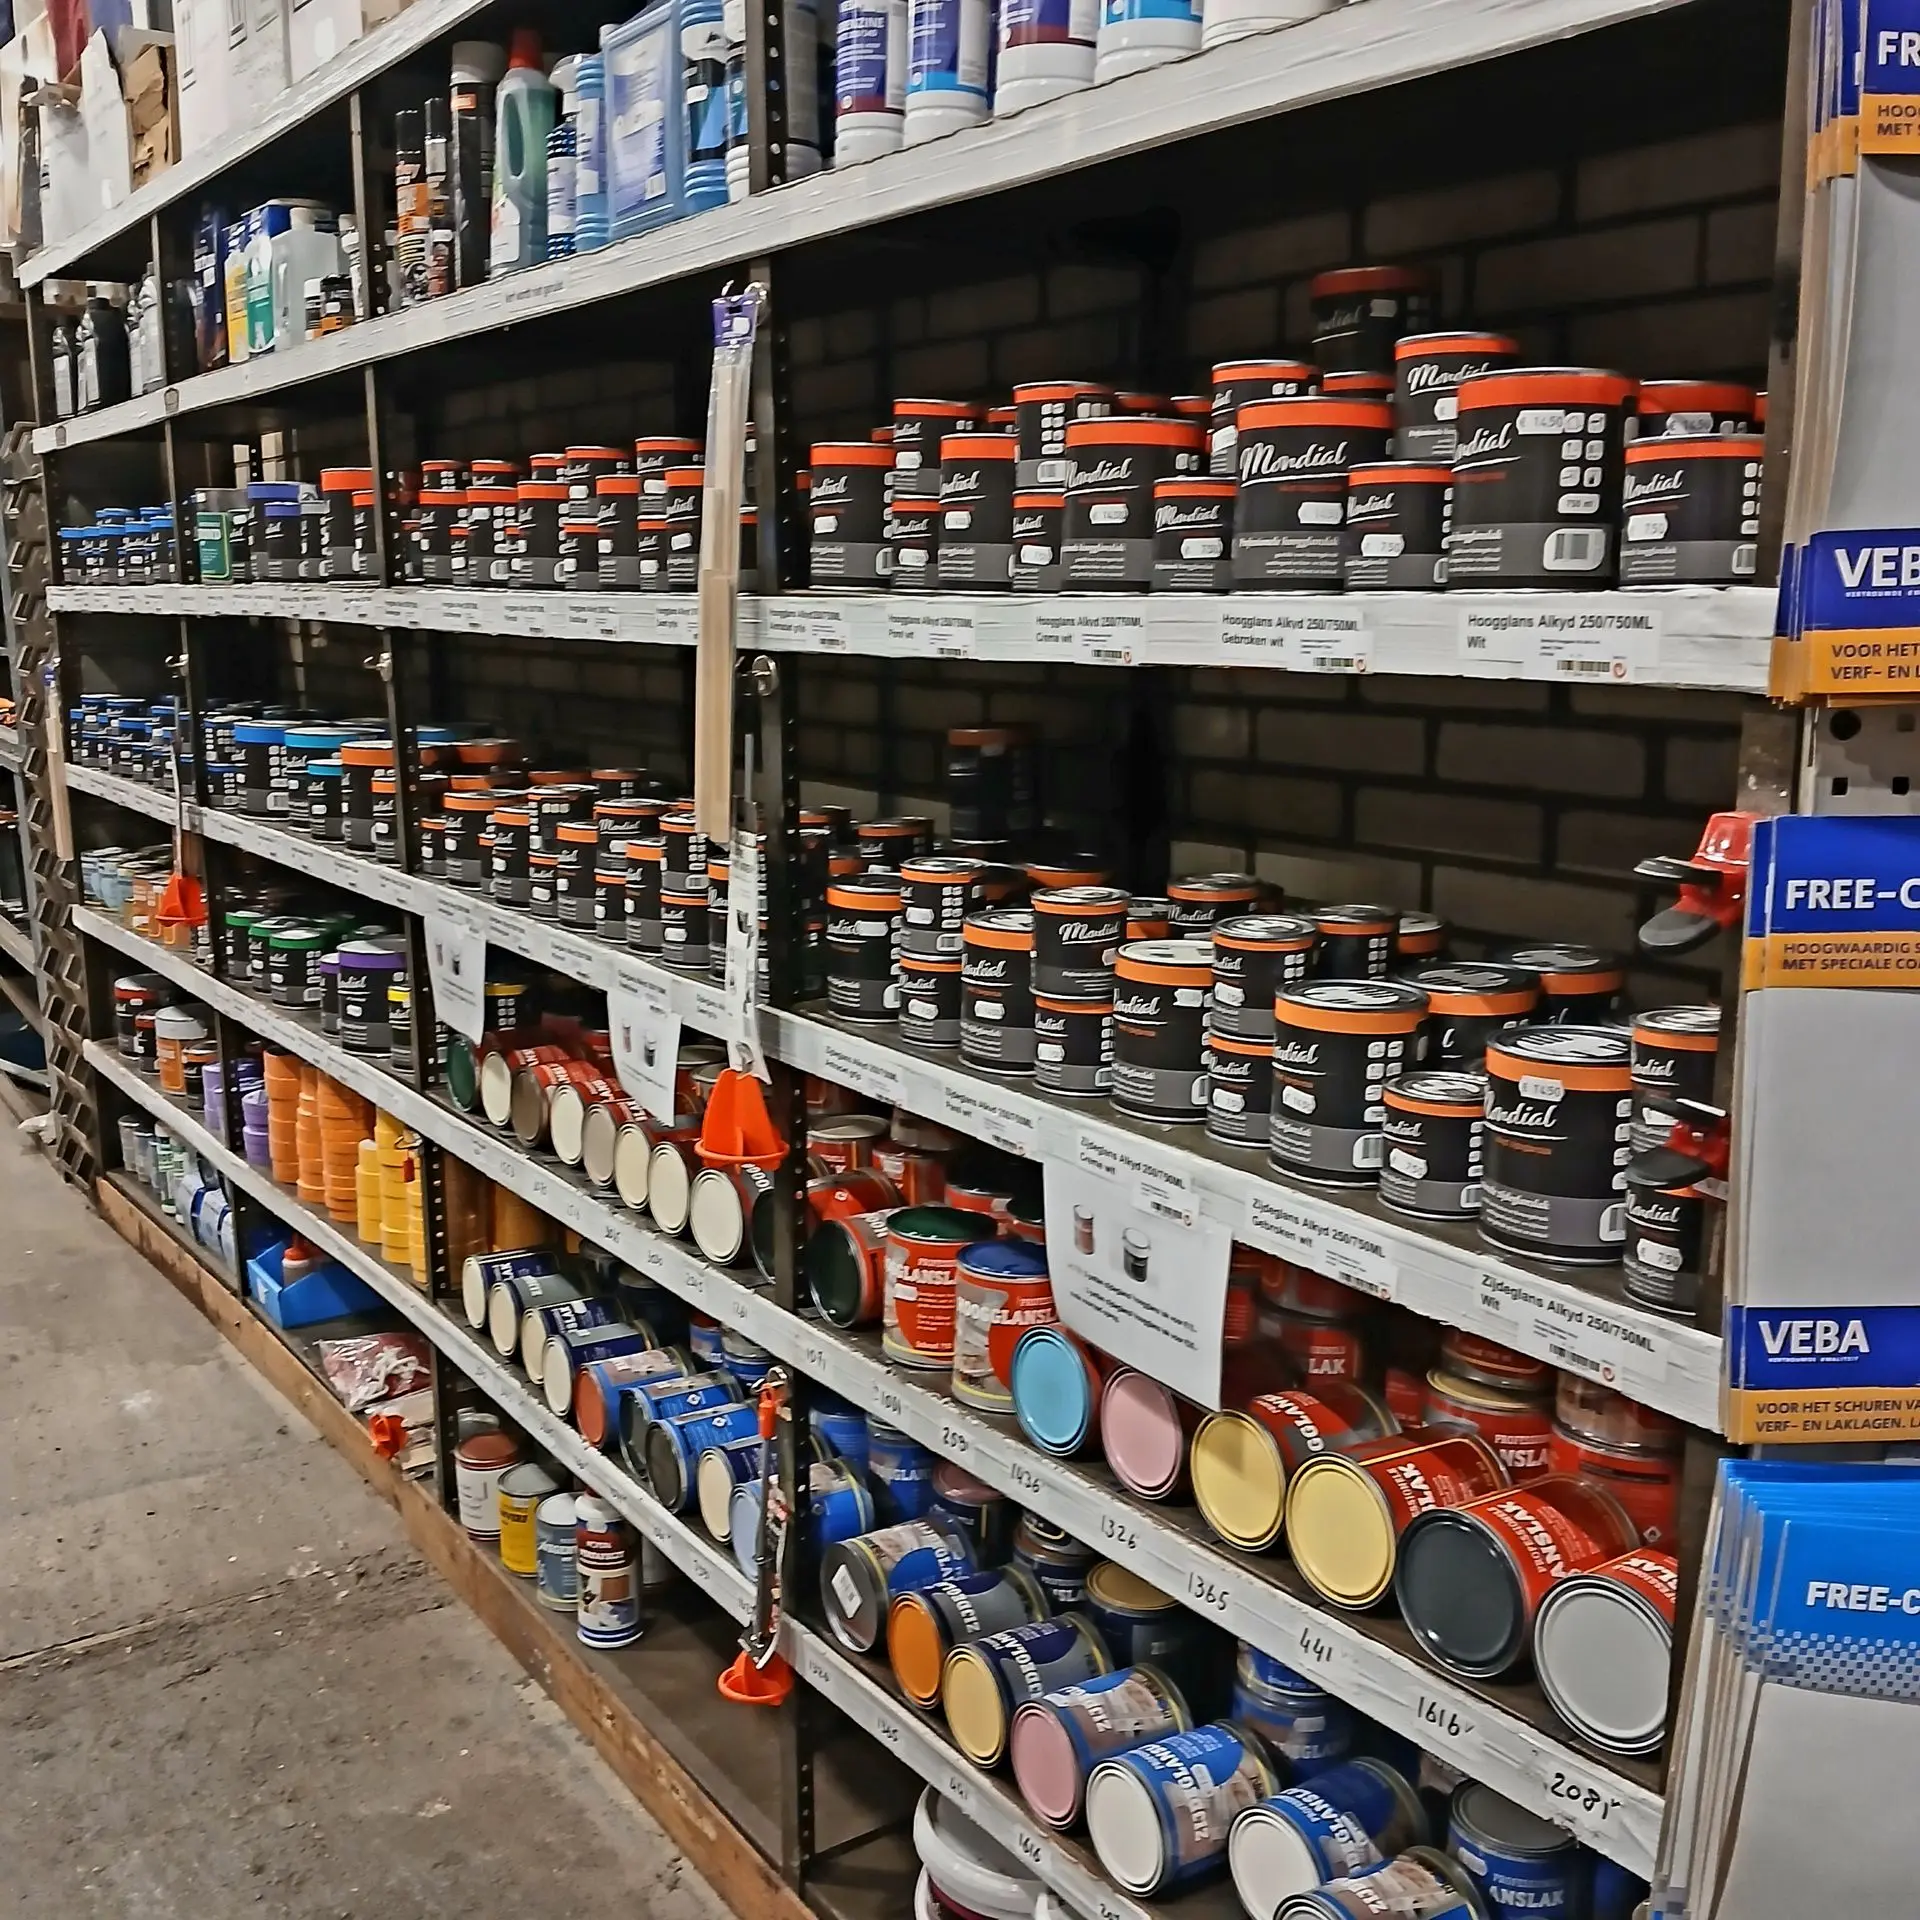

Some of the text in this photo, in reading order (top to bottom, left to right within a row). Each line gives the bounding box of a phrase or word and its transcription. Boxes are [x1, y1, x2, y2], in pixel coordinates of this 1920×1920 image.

[1877, 124, 1911, 136] MET
[1240, 442, 1349, 482] Mondial
[1036, 615, 1074, 629] Hoogglans
[1222, 614, 1361, 632] Hoogglans Alkyd 250/750ML
[1468, 614, 1656, 632] Hoogglans Alkyd 250/750ML
[1221, 632, 1267, 646] Gebroken
[1269, 636, 1285, 648] wit
[1467, 636, 1487, 649] Wit
[1831, 643, 1920, 659] VOOR HET
[1831, 665, 1910, 680] VERF- EN
[1785, 878, 1920, 911] FREE-C
[1783, 943, 1911, 955] HOOGWAARDIG
[1782, 958, 1817, 970] MET
[1819, 957, 1892, 970] SPECIALE
[1252, 1198, 1386, 1259] Zijdeglans Alkyd 250/750ML
[1252, 1215, 1313, 1248] Gebroken wit
[1481, 1293, 1500, 1311] Wit
[1482, 1274, 1656, 1353] Zijdeglans Alkyd 250/750ML
[1758, 1319, 1871, 1355] VEBA
[1307, 1357, 1346, 1376] LAK
[1756, 1402, 1799, 1415] VOOR
[1802, 1401, 1831, 1414] HET
[1834, 1400, 1902, 1413] SCHUREN
[1756, 1420, 1799, 1433] VERF-
[1802, 1420, 1821, 1432] EN
[1825, 1418, 1906, 1431] LAKLAGEN.
[1100, 1515, 1137, 1550] 1326
[1187, 1571, 1231, 1611] 1365
[1806, 1581, 1920, 1615] FREE-C
[1299, 1627, 1333, 1662] 441
[1417, 1696, 1461, 1737] 1616
[1550, 1772, 1609, 1820] 2081
